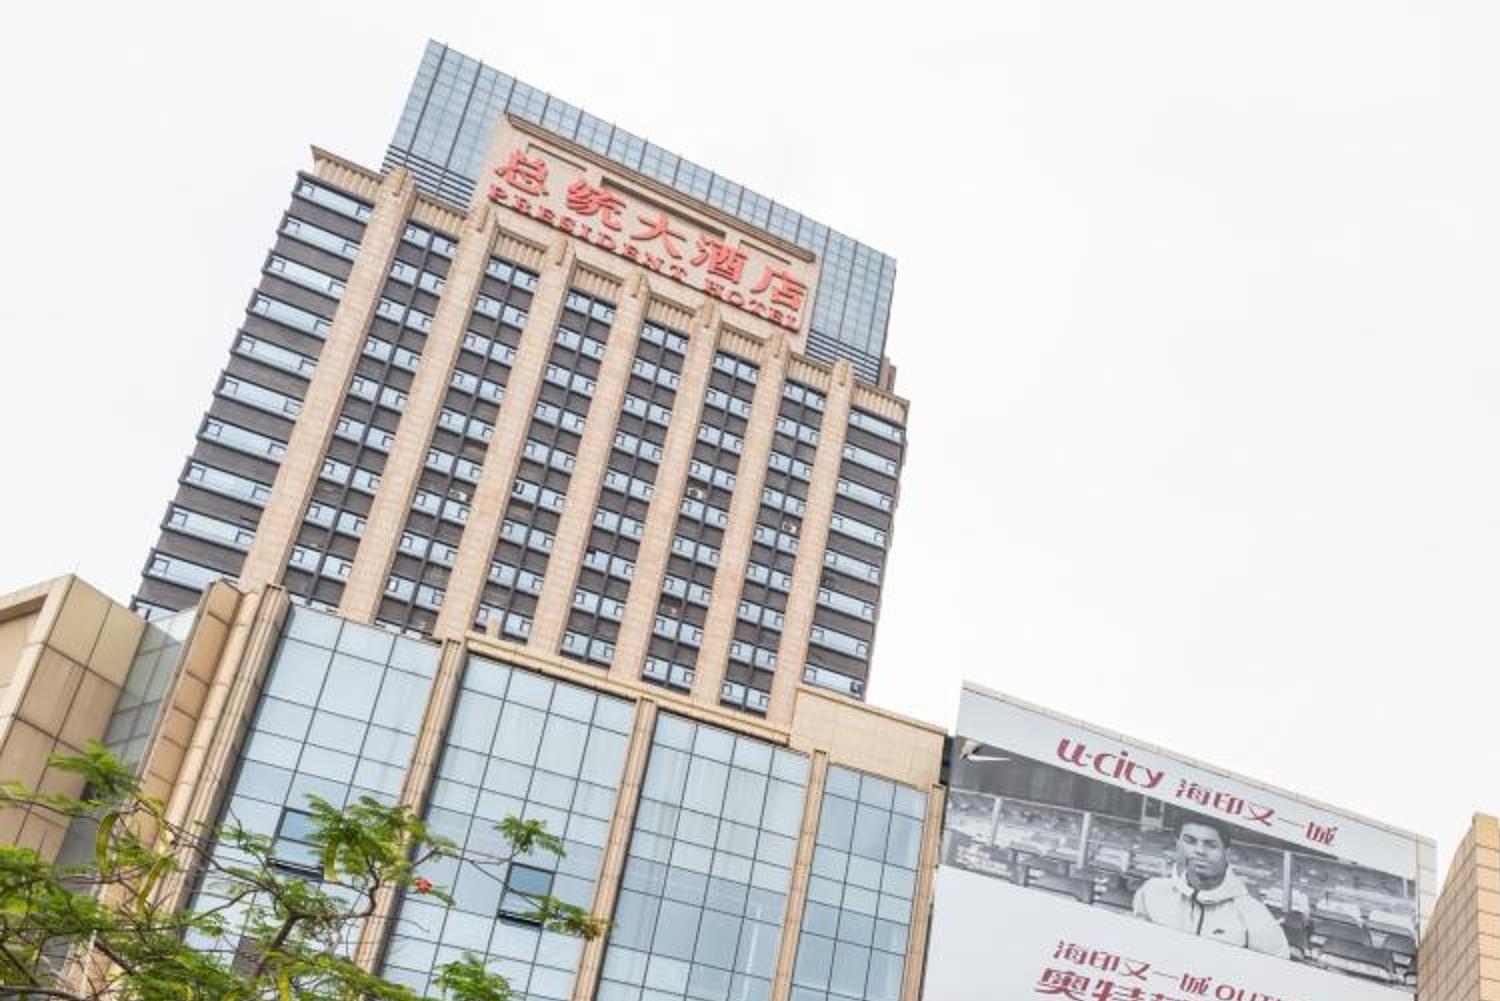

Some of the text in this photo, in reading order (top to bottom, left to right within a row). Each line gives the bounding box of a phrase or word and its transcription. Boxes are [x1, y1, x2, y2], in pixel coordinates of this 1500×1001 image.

[493, 148, 808, 312] 总统大酒店
[1175, 777, 1338, 847] 海印又一城
[1053, 940, 1210, 996] 海印又一城
